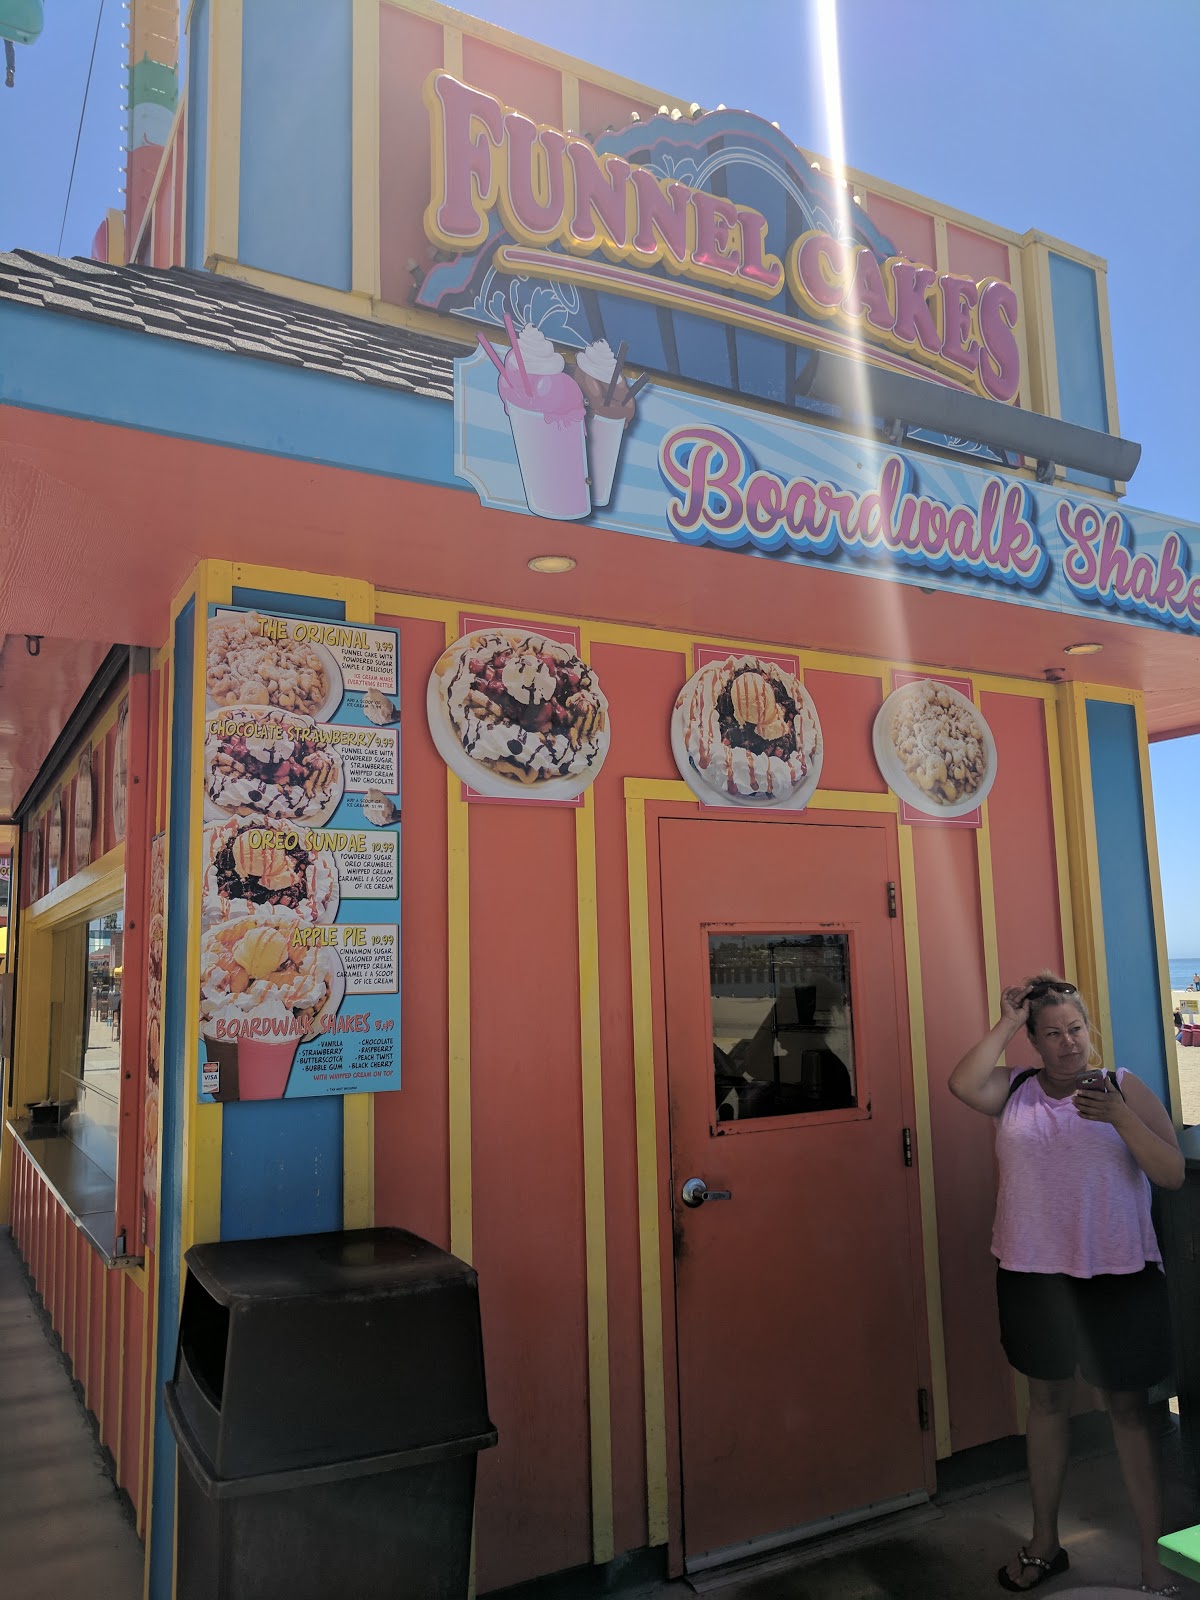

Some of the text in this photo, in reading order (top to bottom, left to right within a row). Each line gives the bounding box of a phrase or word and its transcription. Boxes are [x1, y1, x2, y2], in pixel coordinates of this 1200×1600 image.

[425, 69, 1020, 403] FUNNEL CAKES
[659, 424, 1043, 579] Boardwalk
[258, 618, 393, 652] THE ORIGINAL 7.99
[341, 648, 363, 657] FUNNEL
[343, 656, 373, 665] POWDERED
[366, 666, 393, 674] DELICIOUS
[347, 679, 375, 687] EVERYTHING
[209, 720, 394, 748] CHOCOLATE STRAWBERRY 9.99
[363, 777, 394, 785] CHOCOLATE
[248, 830, 394, 853] OREO SUNDAE 10.99
[292, 927, 394, 947] APPLE PIE 10.99
[215, 1016, 315, 1039] BOARDWALK
[320, 1012, 370, 1036] SHAKES
[362, 1038, 393, 1046] CHOCOLATE
[302, 1048, 344, 1056] STRAWBERRY
[361, 1045, 393, 1053] RASPBERRY
[300, 1056, 343, 1064] BUTTERSCOTCH
[370, 1060, 393, 1068] CHERRY
